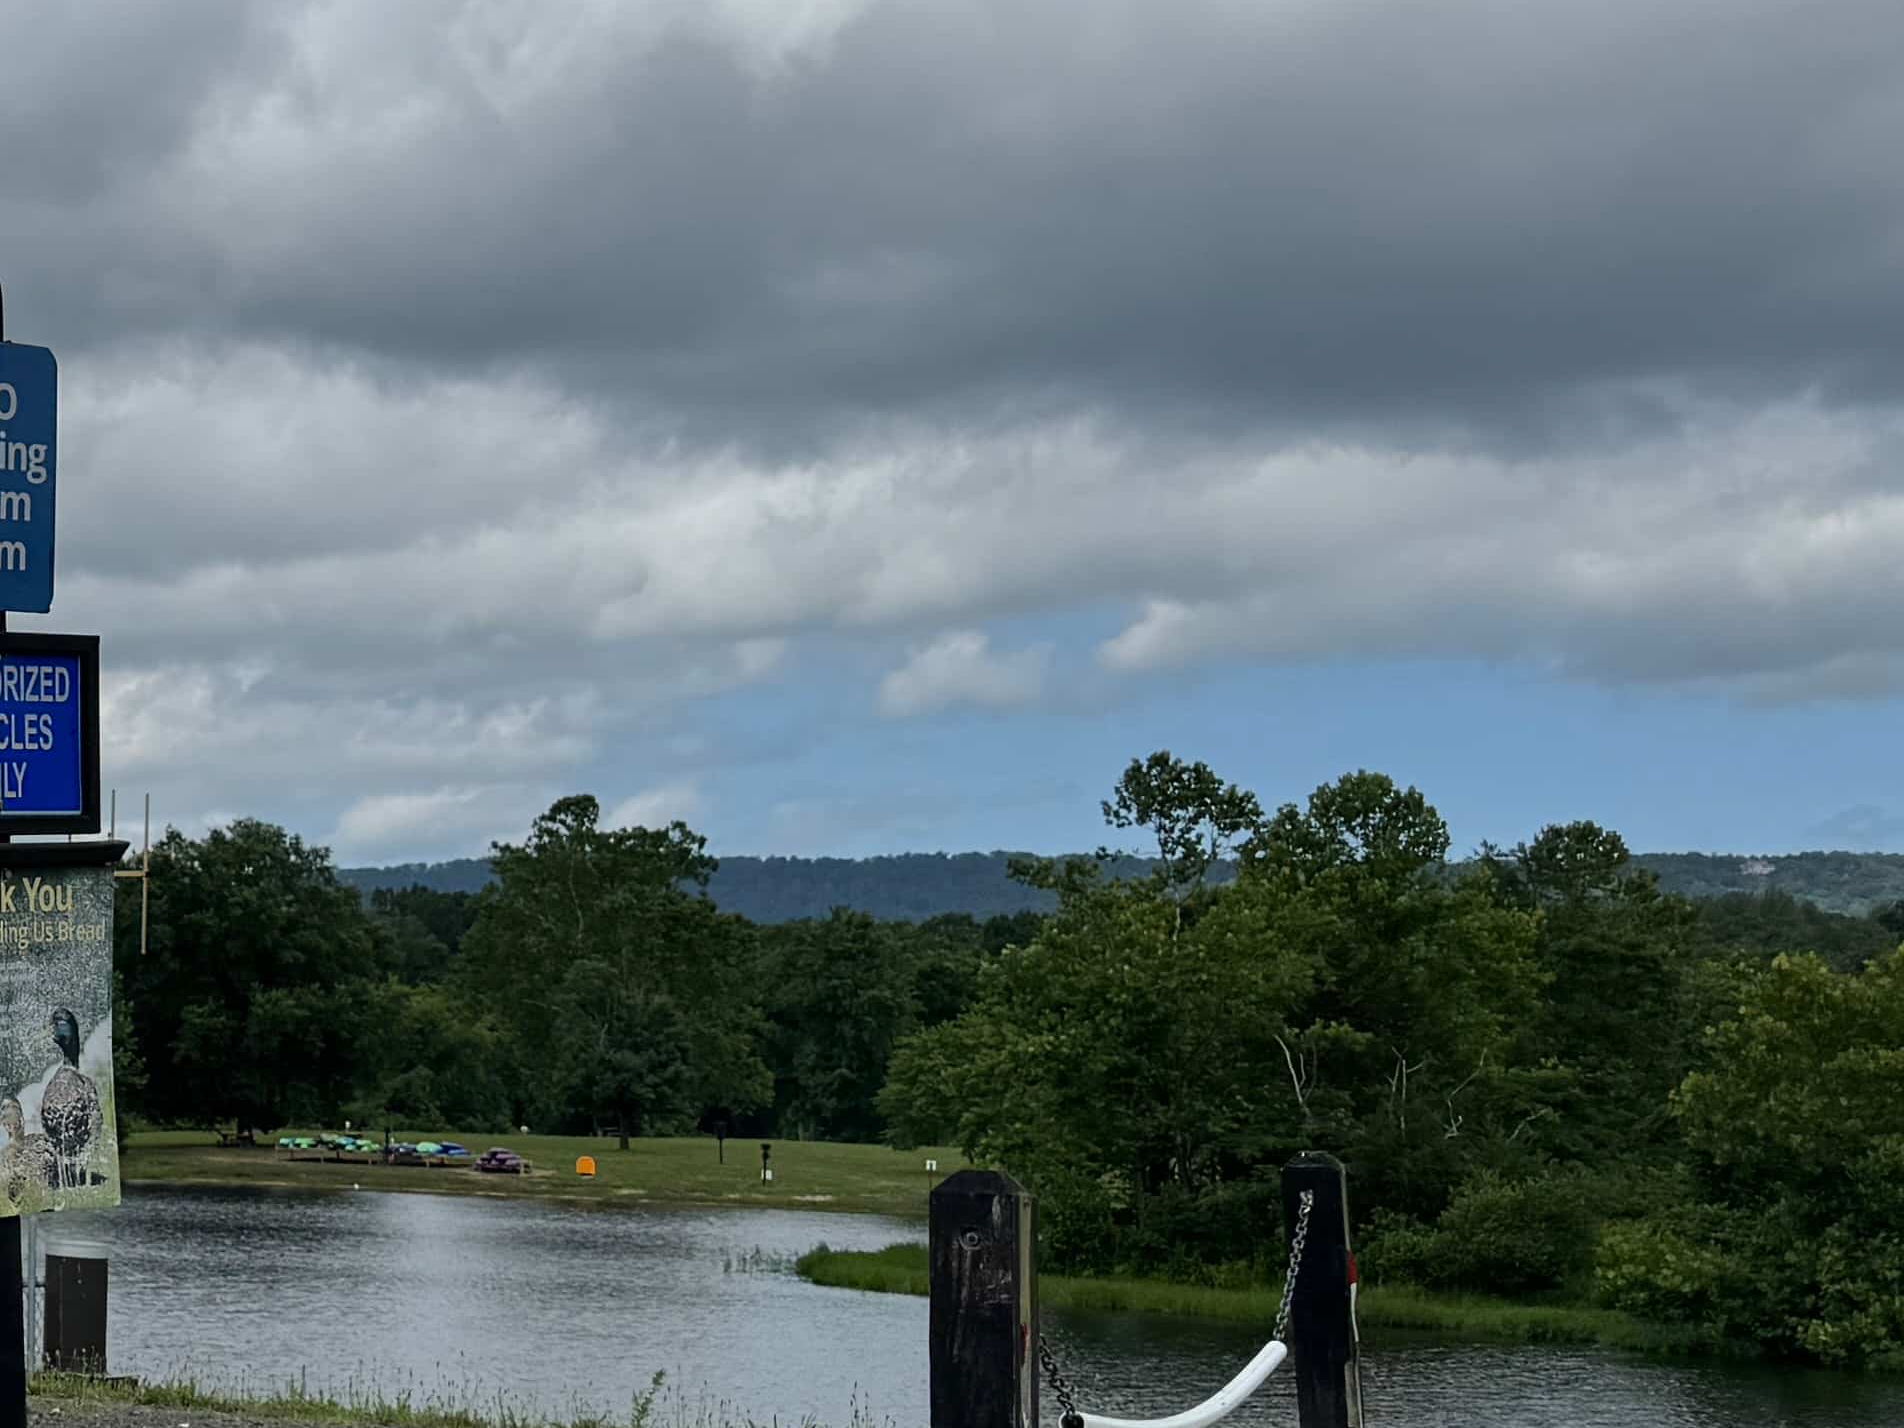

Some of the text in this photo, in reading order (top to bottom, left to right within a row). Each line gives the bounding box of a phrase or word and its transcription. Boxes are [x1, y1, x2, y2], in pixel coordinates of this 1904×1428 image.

[22, 877, 74, 913] You
[33, 921, 55, 943] Us
[58, 919, 106, 942] Bread
